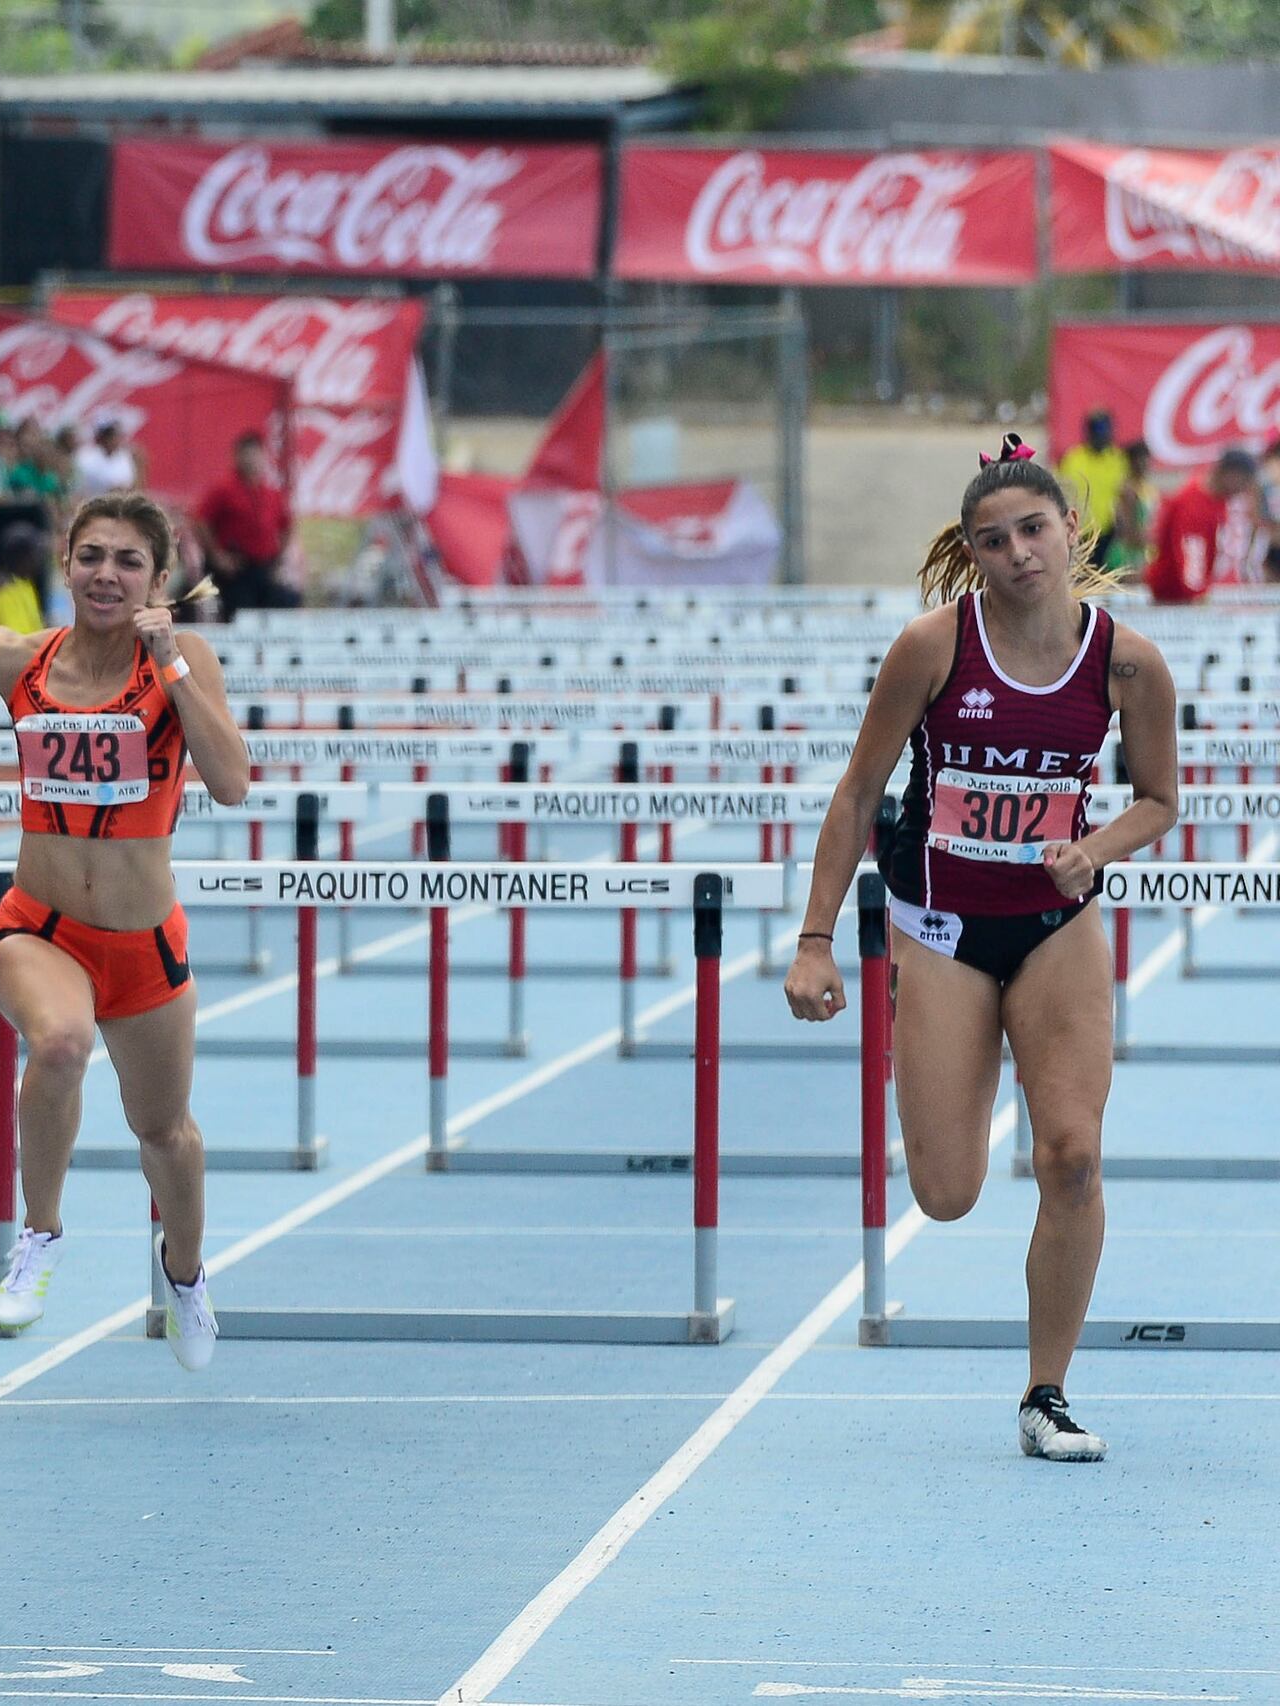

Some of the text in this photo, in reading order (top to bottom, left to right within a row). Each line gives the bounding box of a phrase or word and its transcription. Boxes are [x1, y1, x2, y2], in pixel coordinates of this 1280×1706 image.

[42, 717, 82, 731] Justas
[112, 718, 137, 731] 2018
[42, 732, 120, 782] 243
[44, 786, 91, 797] POPULAR
[967, 777, 1071, 793] Justas LAI 2018
[534, 794, 641, 818] PAQUITO
[650, 794, 788, 818] MONTANER
[961, 791, 1049, 844] 302
[951, 843, 1009, 858] POPULAR
[199, 872, 670, 902] UCS PAQUITO MONTANER UCS
[1140, 872, 1280, 902] MONTAN
